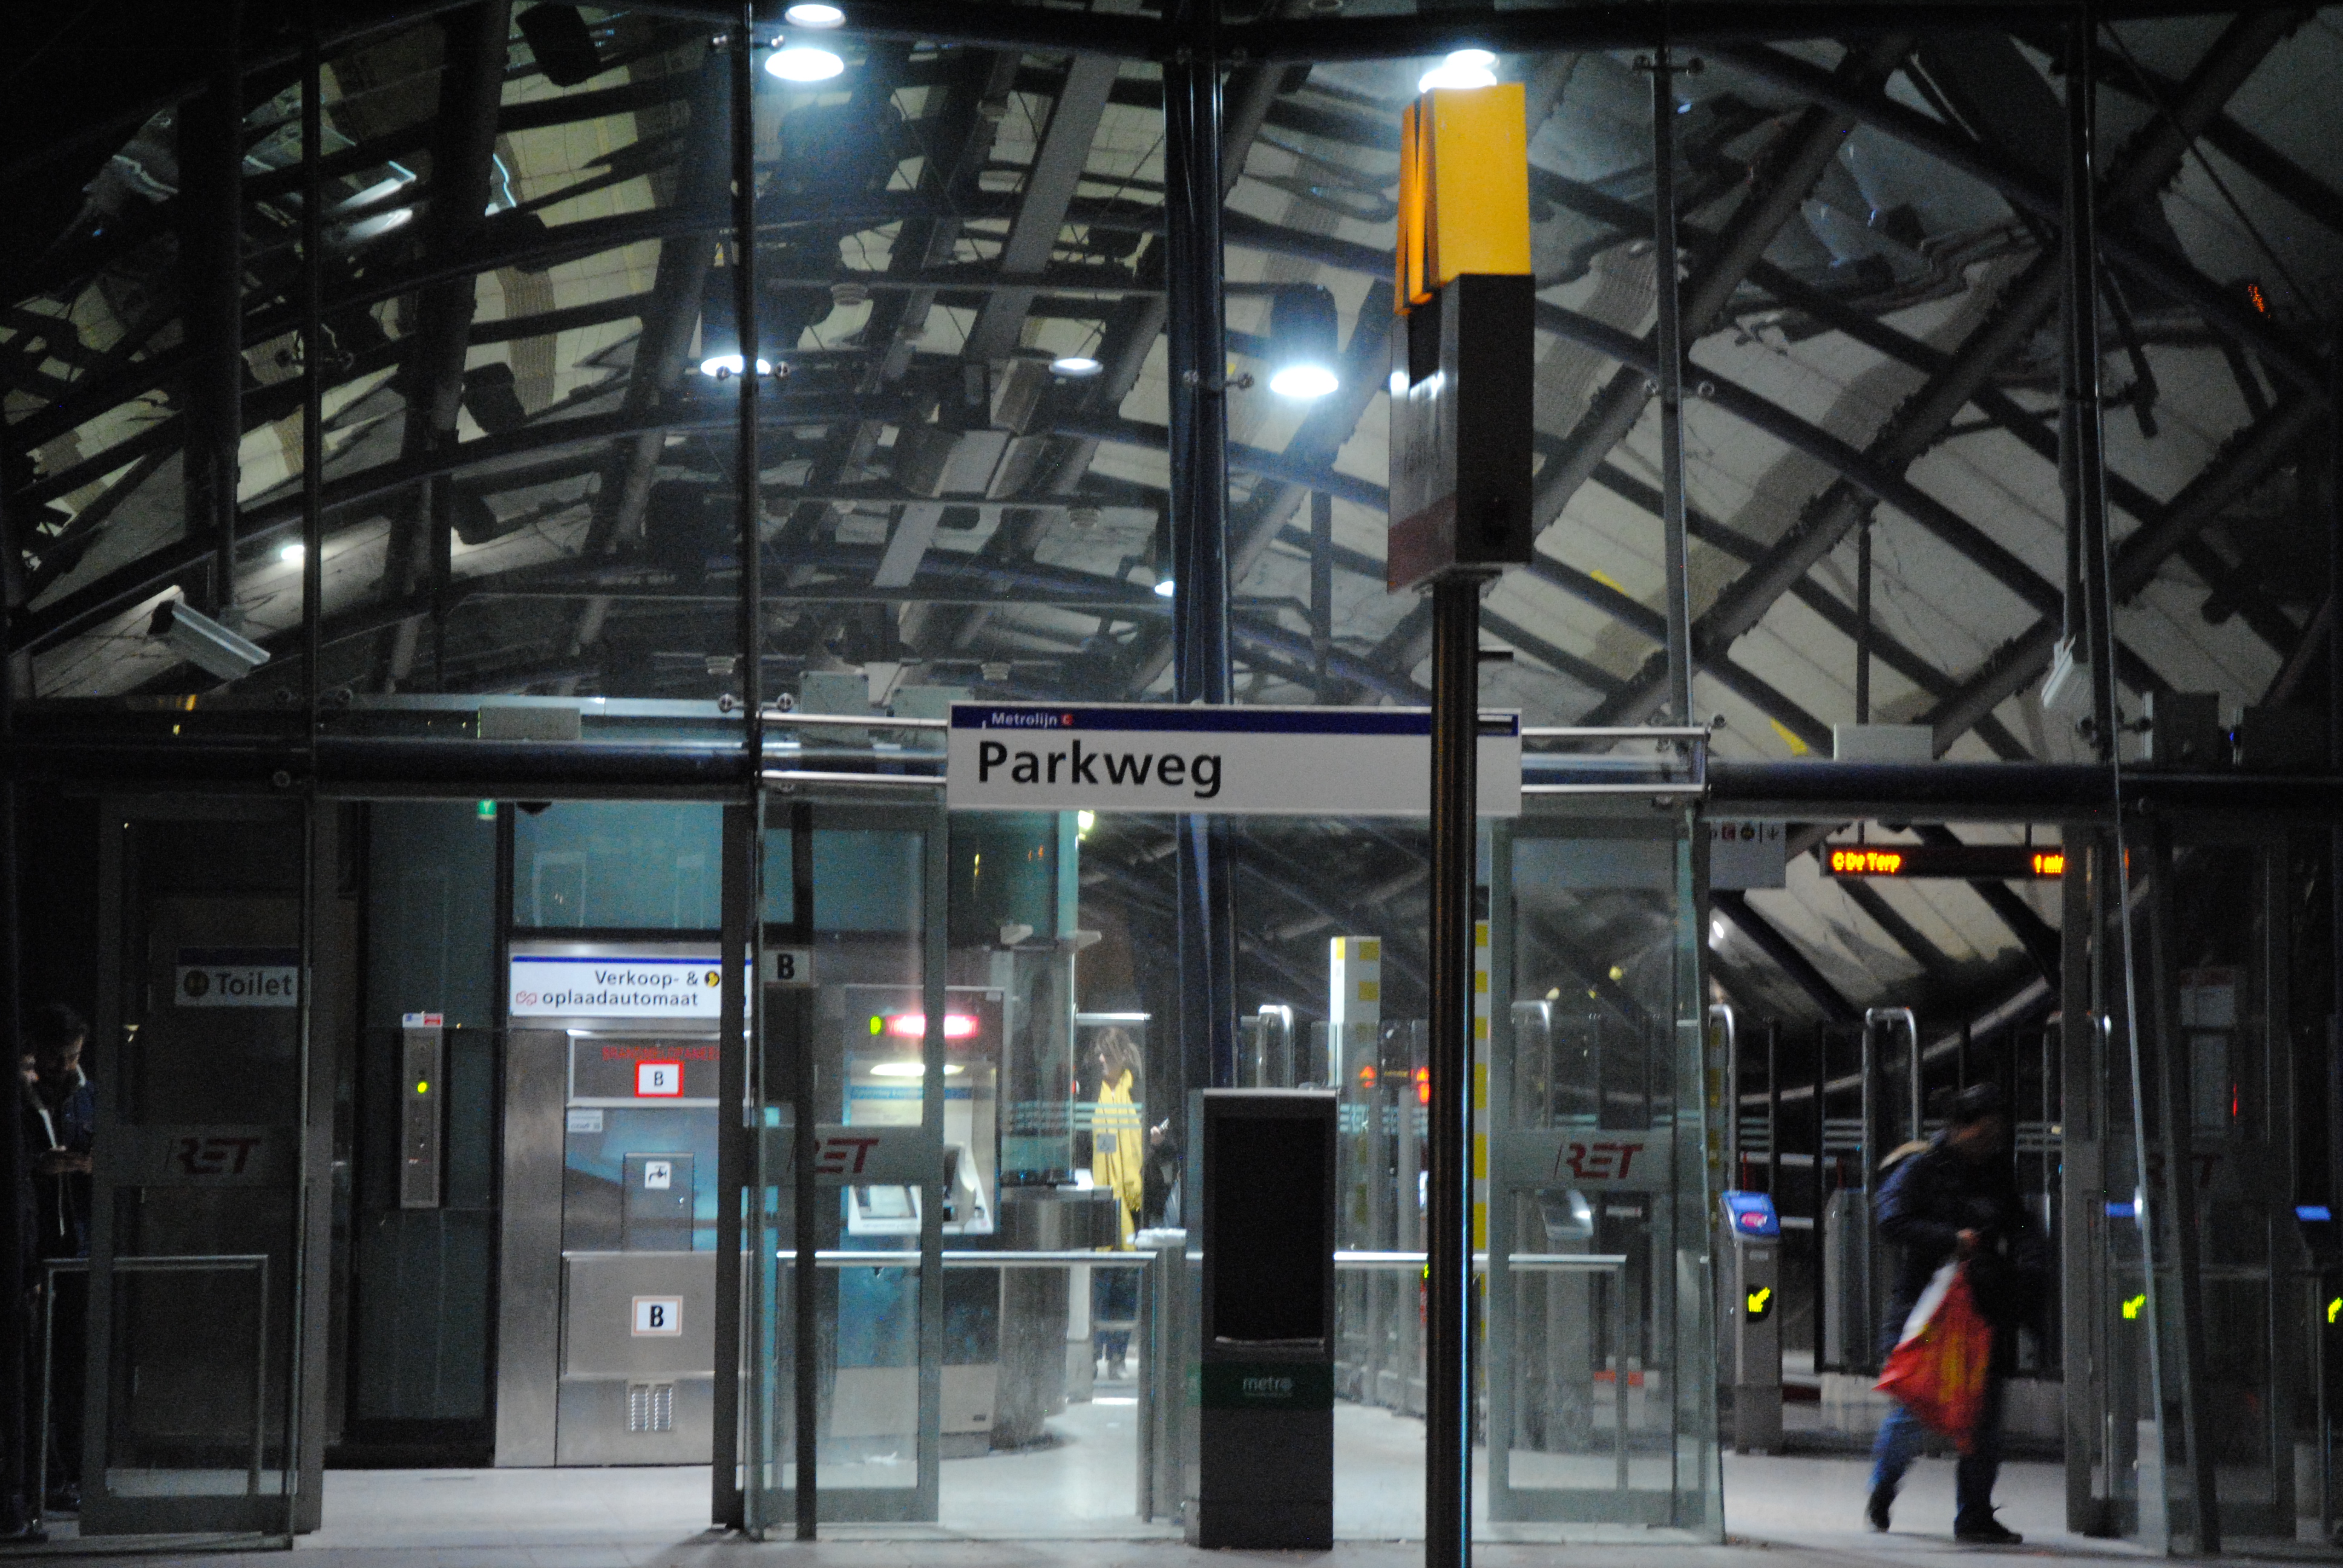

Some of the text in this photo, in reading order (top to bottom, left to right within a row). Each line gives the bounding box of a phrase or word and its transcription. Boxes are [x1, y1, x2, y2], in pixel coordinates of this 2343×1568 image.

[991, 713, 1058, 728] Metrolijn
[978, 739, 1221, 798] Parkweg
[776, 953, 795, 980] B
[214, 971, 292, 996] Toilet
[595, 970, 699, 988] Verkoop- &
[542, 990, 698, 1007] oplaadautomaat
[654, 1071, 664, 1087] B
[165, 1138, 263, 1174] RET
[1555, 1143, 1644, 1179] RET
[650, 1305, 664, 1327] B
